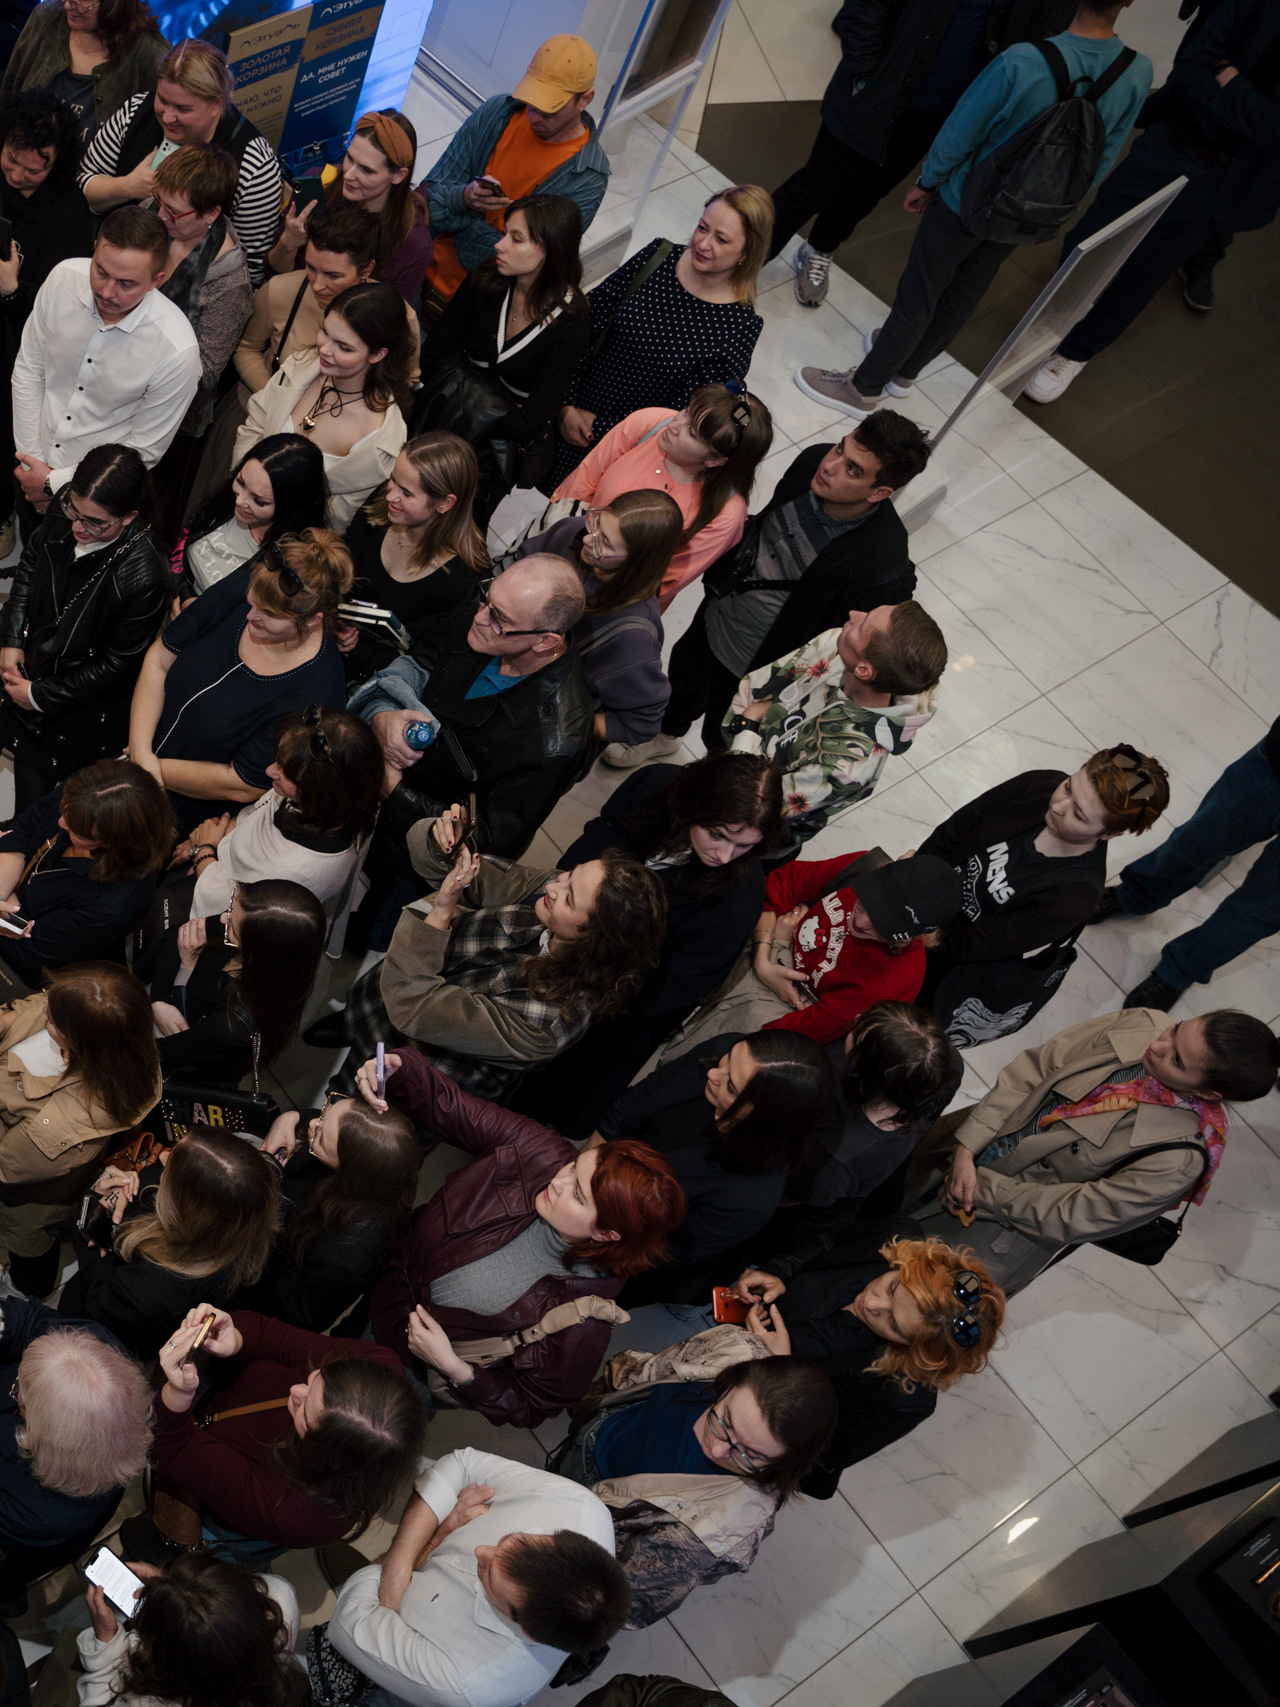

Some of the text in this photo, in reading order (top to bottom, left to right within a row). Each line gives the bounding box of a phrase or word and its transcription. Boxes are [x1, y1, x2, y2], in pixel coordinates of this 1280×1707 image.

[315, 26, 365, 51] КОРЗИНА
[235, 57, 287, 85] КОРЗИНА
[240, 45, 290, 72] ЗОЛОТАЯ
[317, 62, 336, 76] МНЕ
[336, 50, 368, 68] НУЖЕН
[318, 66, 346, 84] СОВЕТ
[235, 94, 260, 108] НАЮ,
[263, 85, 282, 97] ЧТО
[246, 94, 282, 113] НУЖНО
[986, 841, 1016, 905] MENS
[811, 890, 846, 990] LLO KITTY
